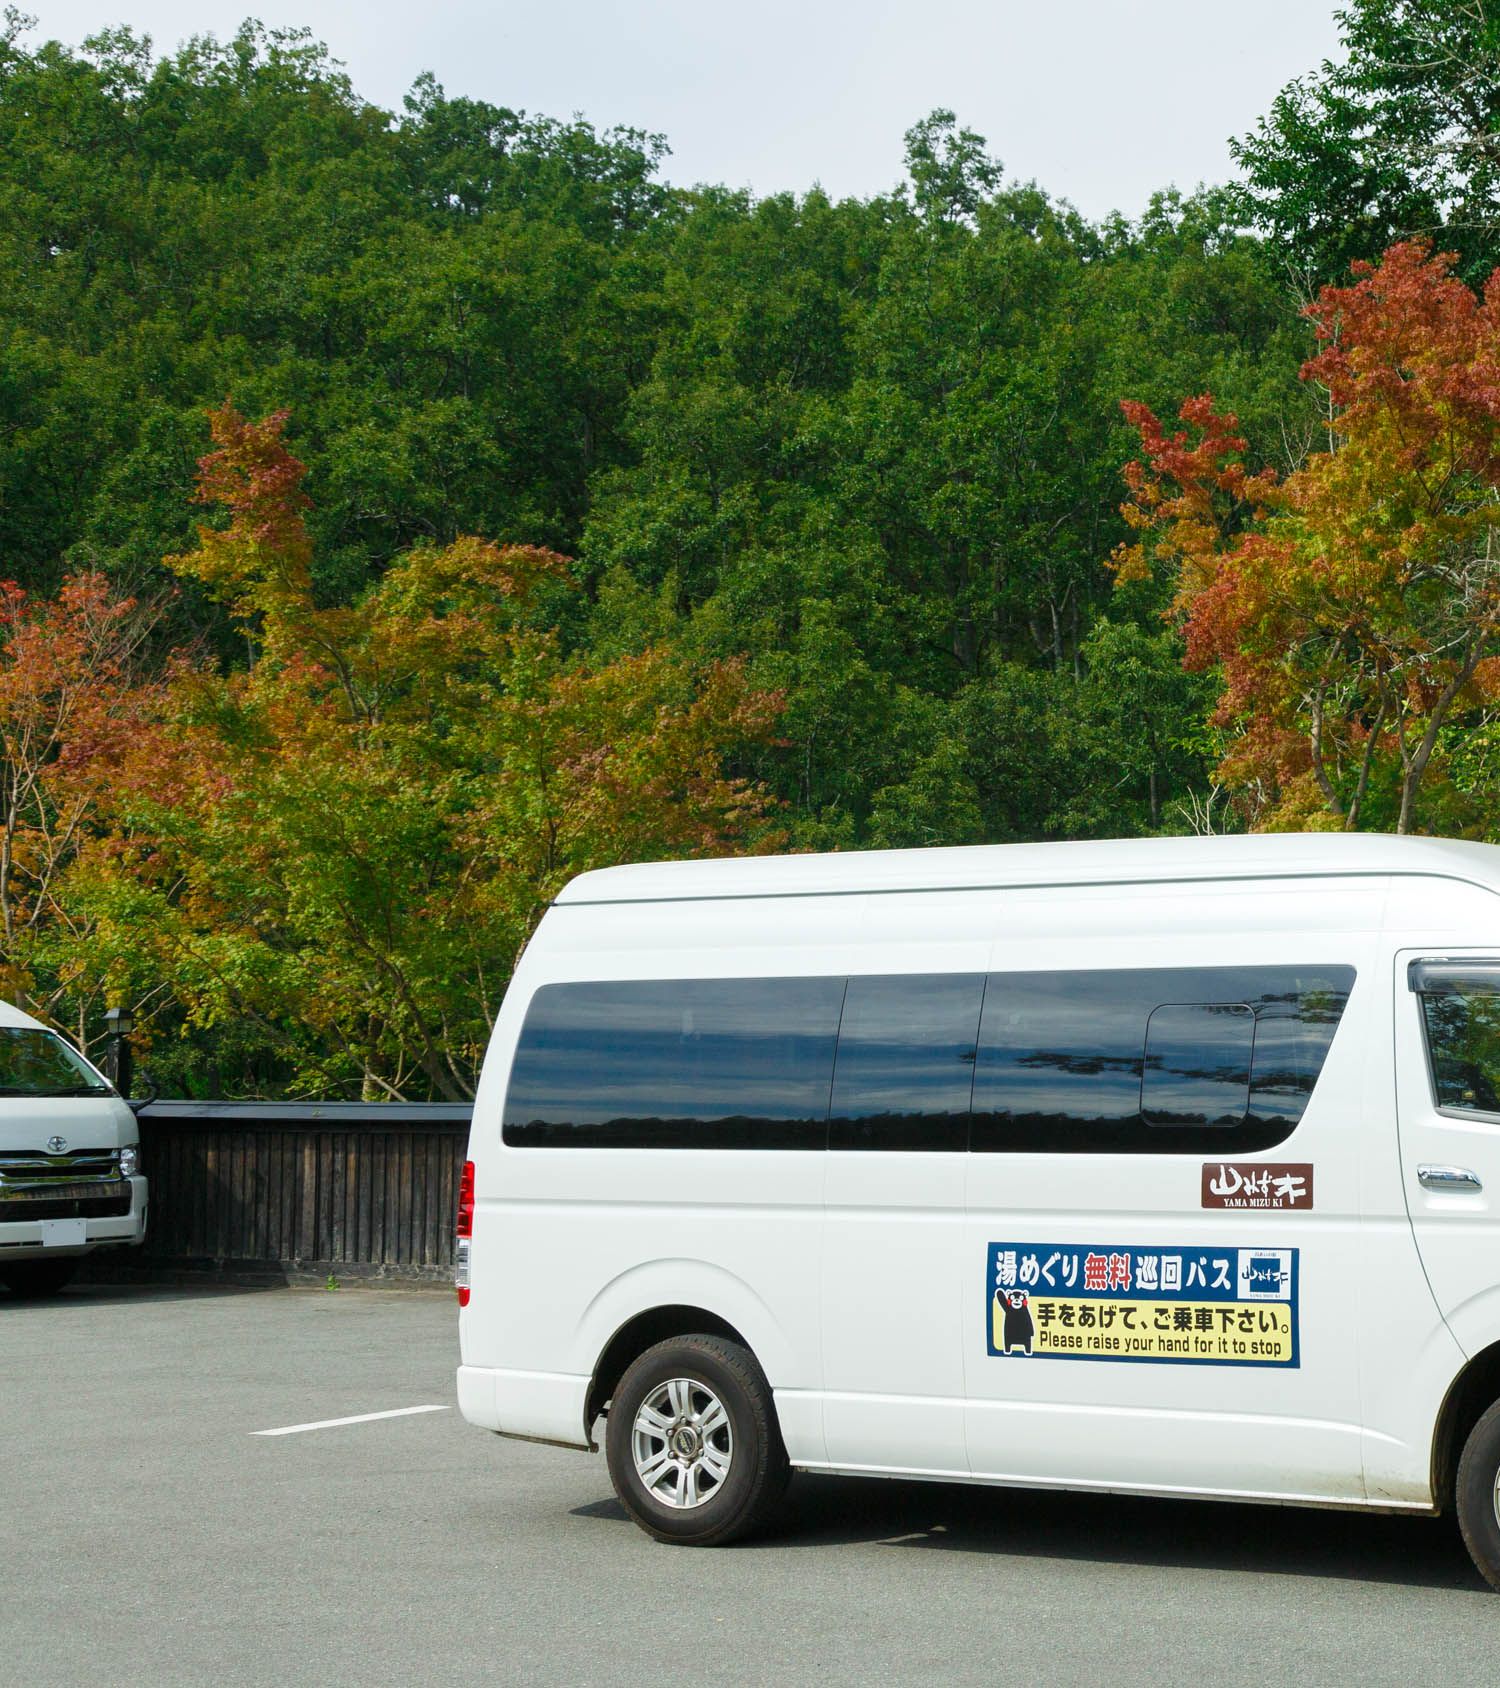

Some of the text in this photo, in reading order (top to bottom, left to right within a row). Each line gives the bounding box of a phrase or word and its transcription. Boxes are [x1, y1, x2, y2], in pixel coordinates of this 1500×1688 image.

[1224, 1198, 1283, 1207] YAMA MIZU KI
[1037, 1303, 1288, 1334] 手をあげて、ご乗車下さい。
[1040, 1331, 1281, 1357] Please raise your hand for it to stop
